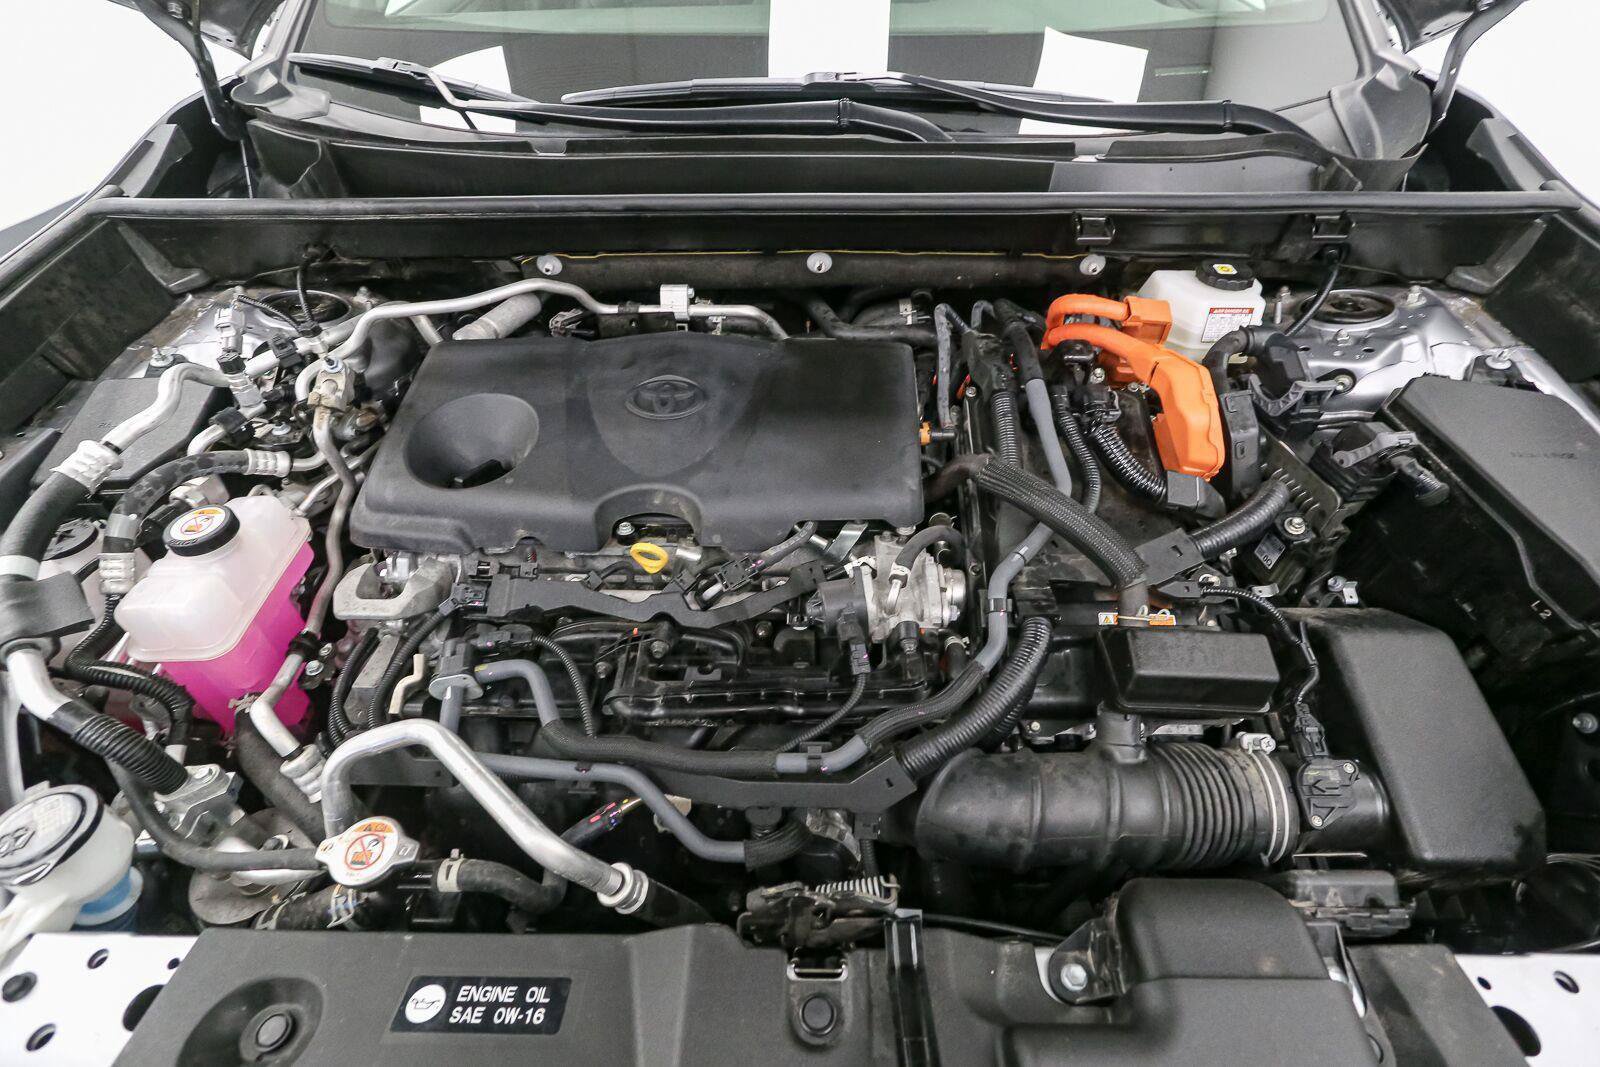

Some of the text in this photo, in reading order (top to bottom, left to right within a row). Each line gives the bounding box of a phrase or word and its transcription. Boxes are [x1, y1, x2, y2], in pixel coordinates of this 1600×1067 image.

[456, 985, 551, 1003] ENGINE OIL
[449, 1006, 546, 1025] SAE 0W-16
